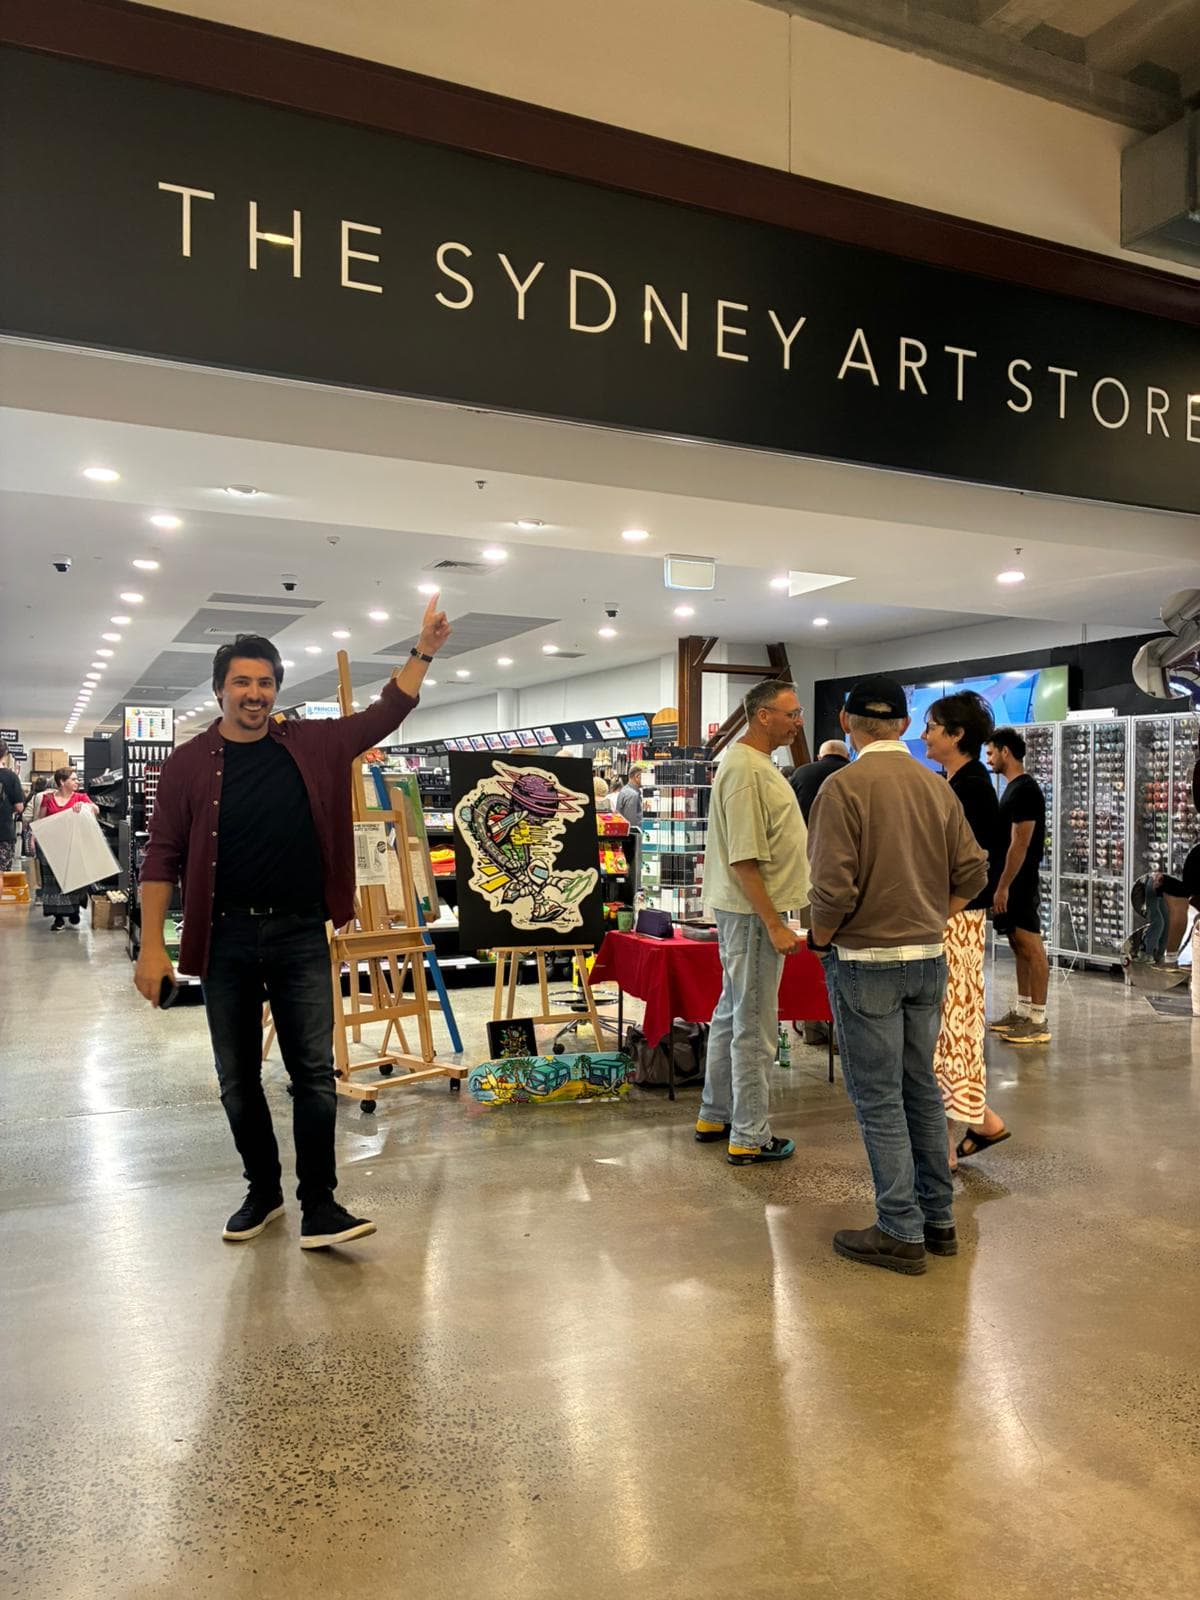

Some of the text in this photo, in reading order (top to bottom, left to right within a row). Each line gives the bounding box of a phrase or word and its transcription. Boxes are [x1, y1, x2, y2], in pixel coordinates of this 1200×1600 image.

[158, 181, 1200, 444] THE SYDNEY ART STORE
